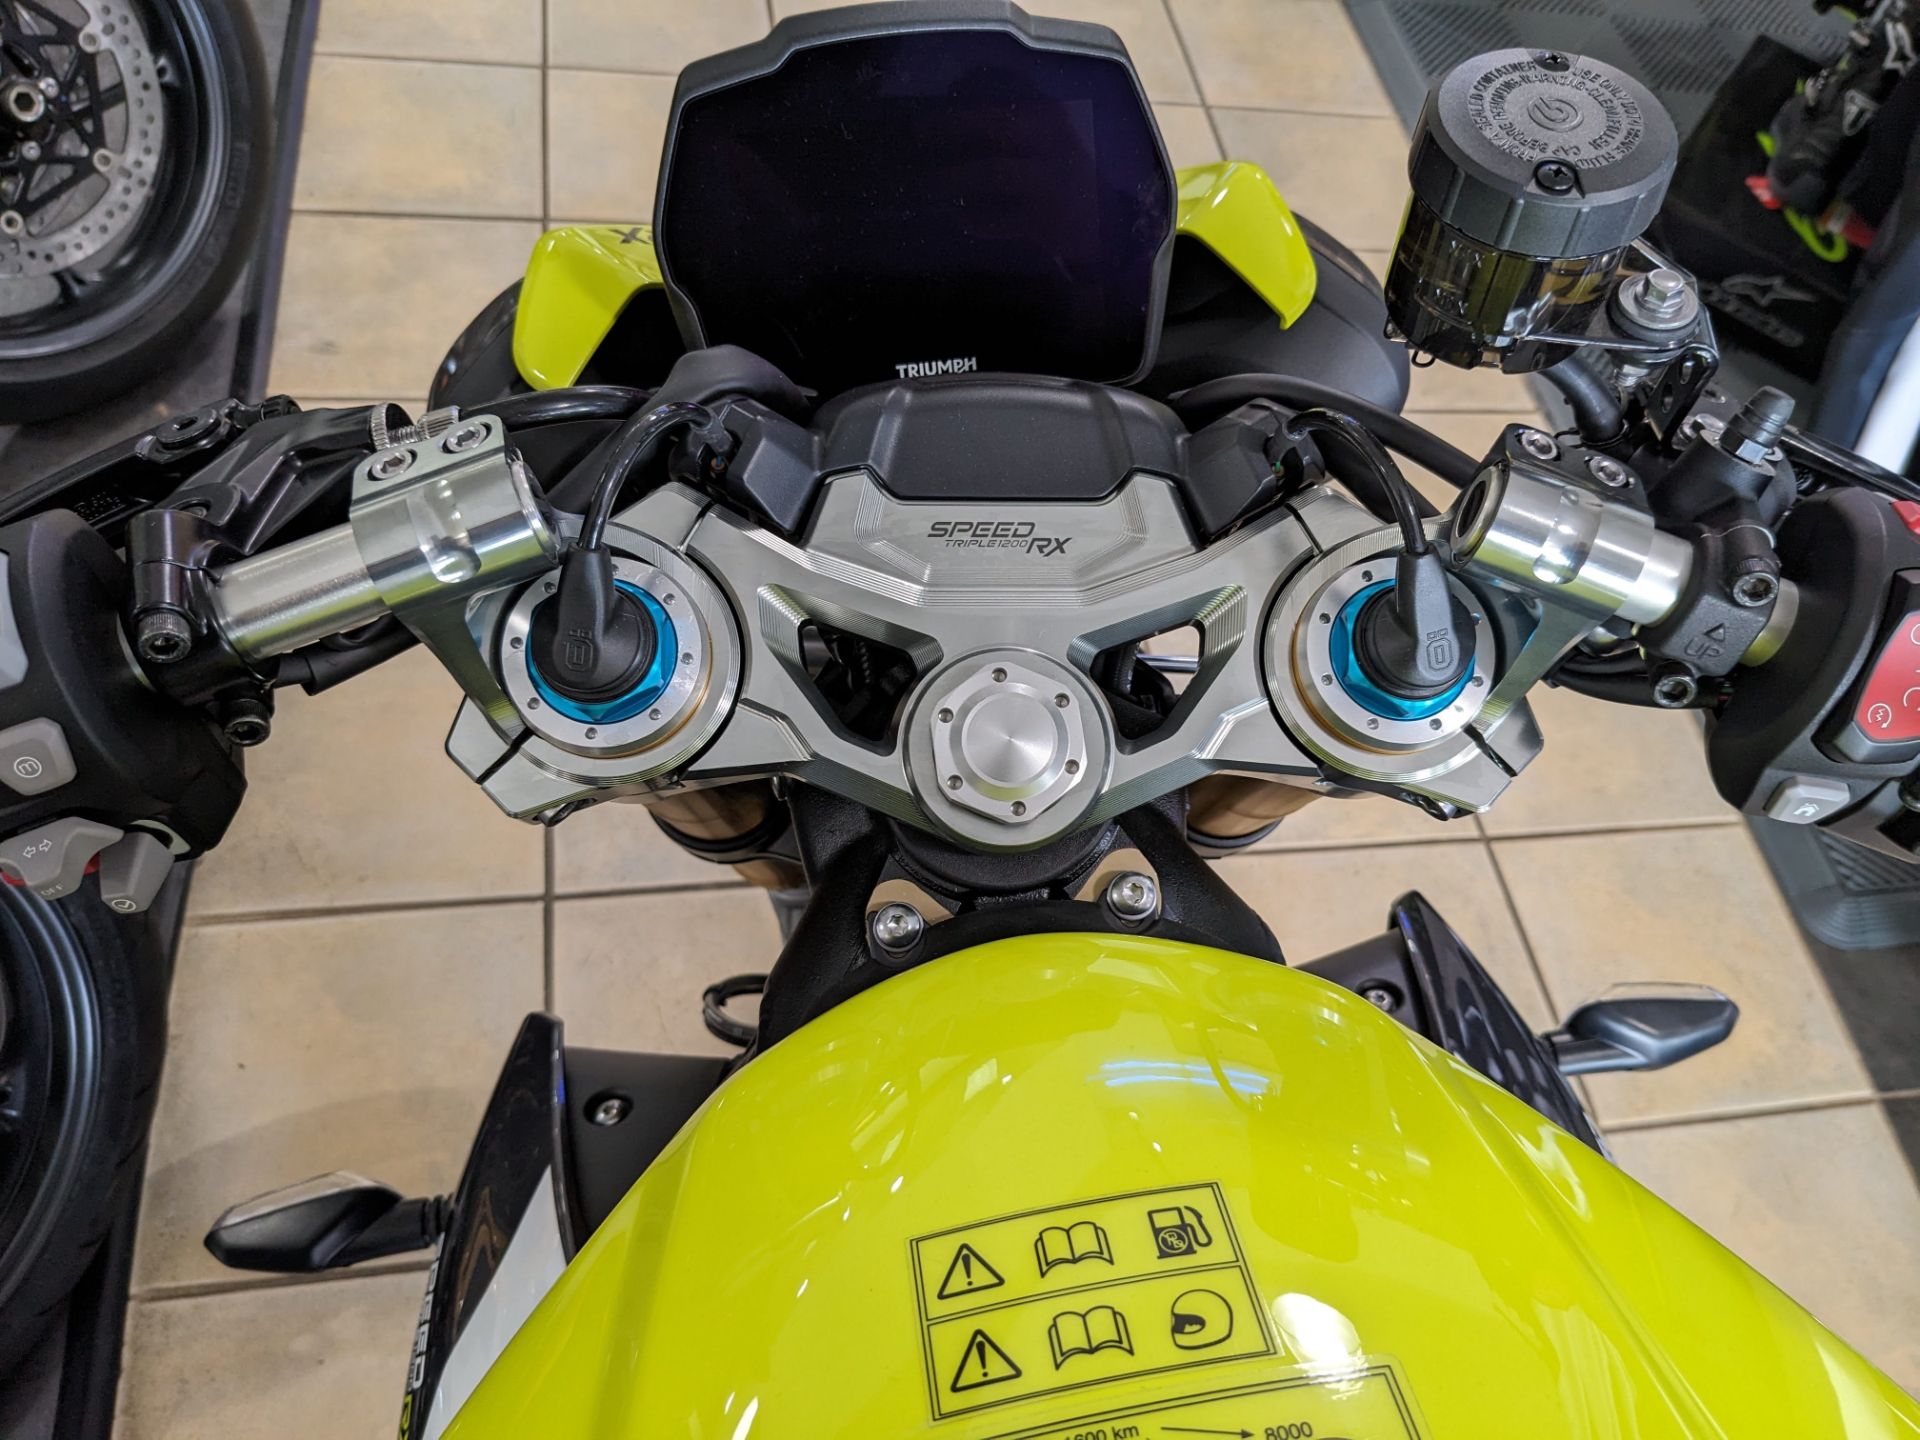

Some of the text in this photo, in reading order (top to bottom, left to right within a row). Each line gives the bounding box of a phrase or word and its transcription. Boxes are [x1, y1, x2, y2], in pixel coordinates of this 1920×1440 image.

[1473, 61, 1537, 92] CONTAINER
[1572, 68, 1602, 83] USE
[1599, 79, 1632, 101] ONLY
[1468, 93, 1493, 131] SEALED
[1499, 122, 1549, 154] BEFORE
[1551, 145, 1581, 157] CAP
[895, 357, 977, 378] TRIUMPH
[927, 521, 1036, 538] SPEED
[1025, 537, 1073, 557] RX
[1684, 638, 1723, 659] UP
[1111, 1425, 1139, 1440] km
[1264, 1421, 1313, 1440] 8000
